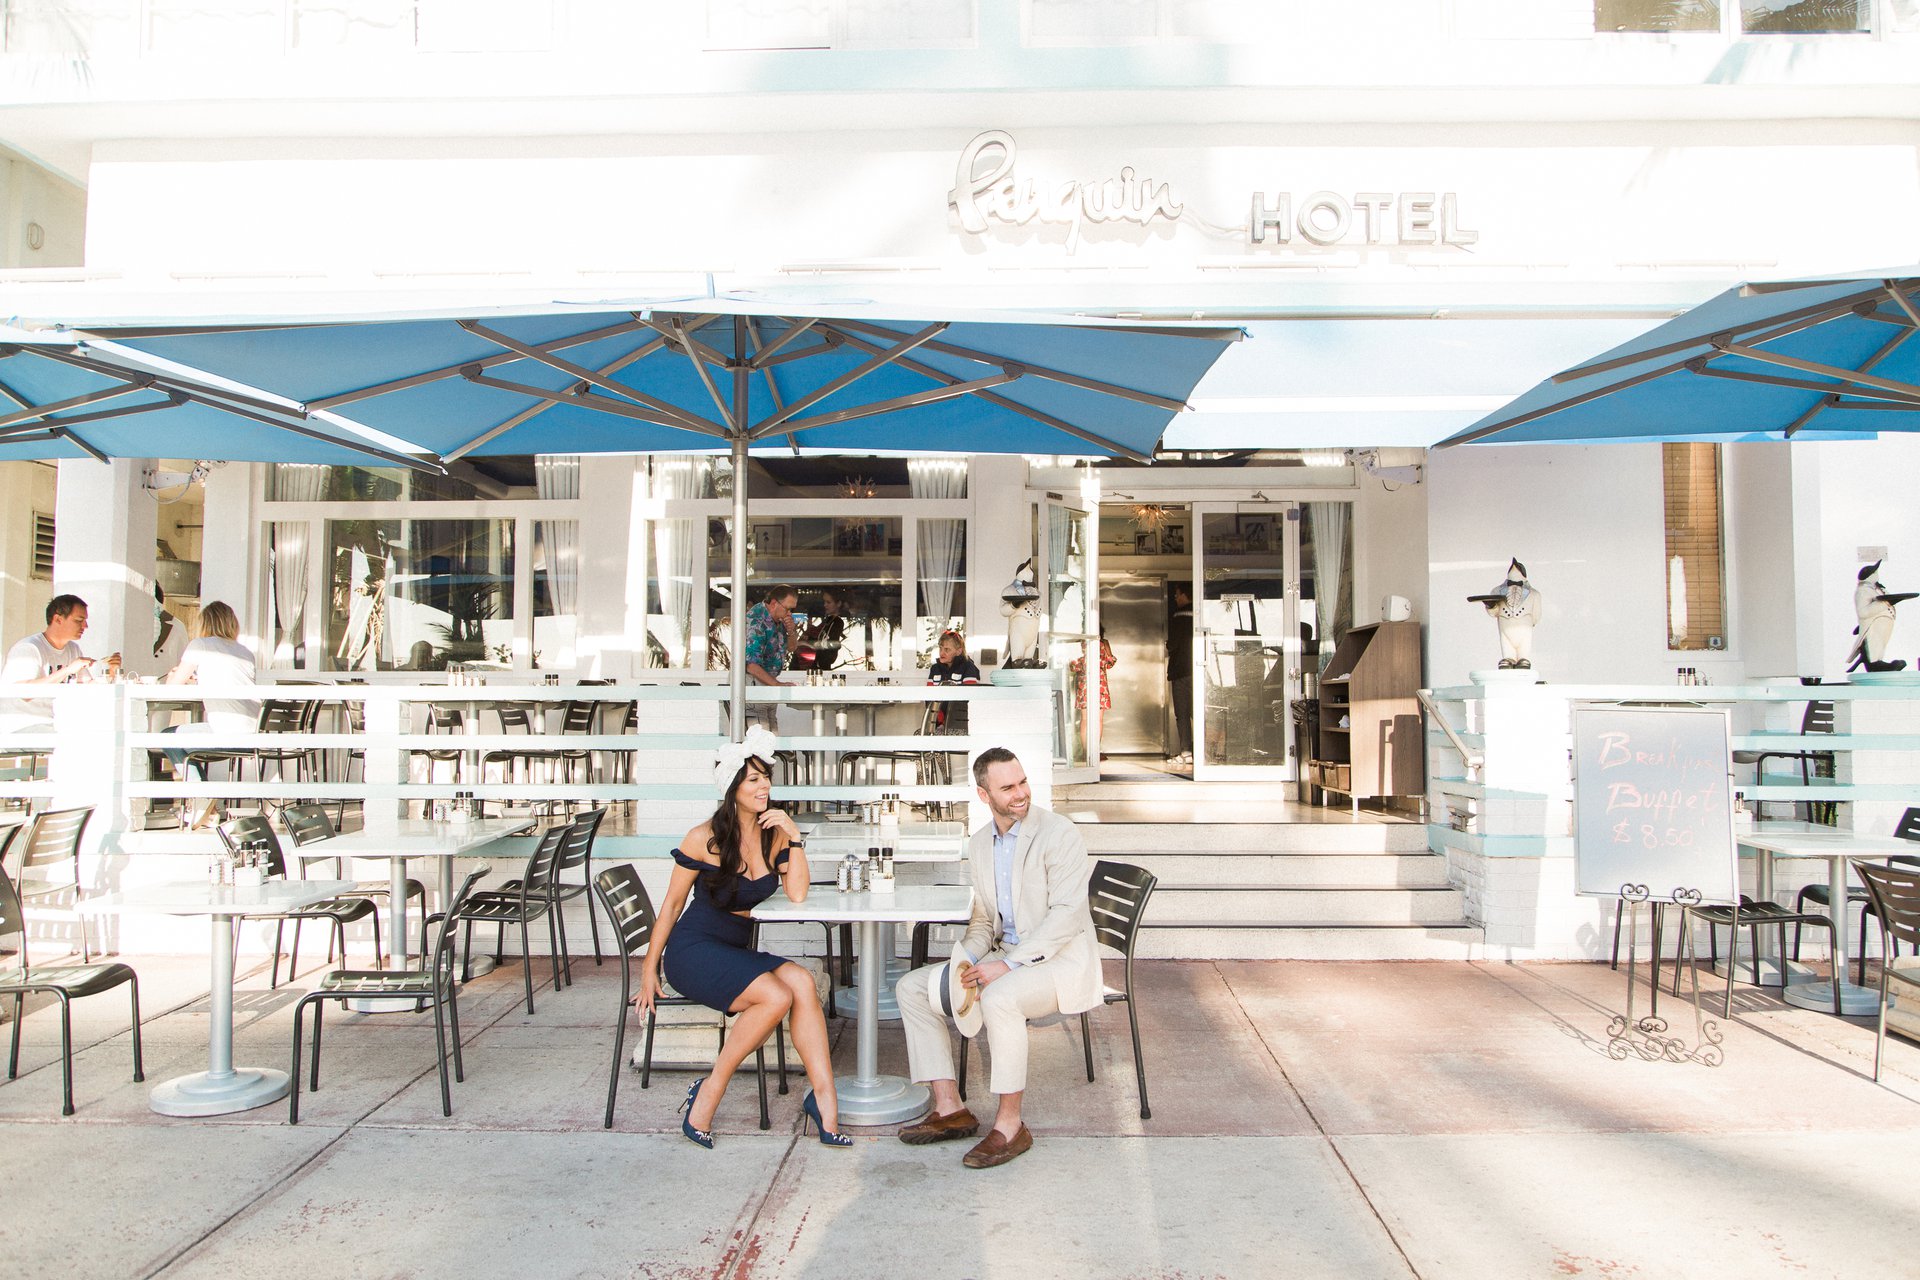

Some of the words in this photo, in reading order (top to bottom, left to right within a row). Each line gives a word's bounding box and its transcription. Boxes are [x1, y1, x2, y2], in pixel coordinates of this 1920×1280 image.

[947, 129, 1185, 256] Penguin
[1251, 190, 1479, 247] HOTEL
[1606, 782, 1720, 822] Buffet
